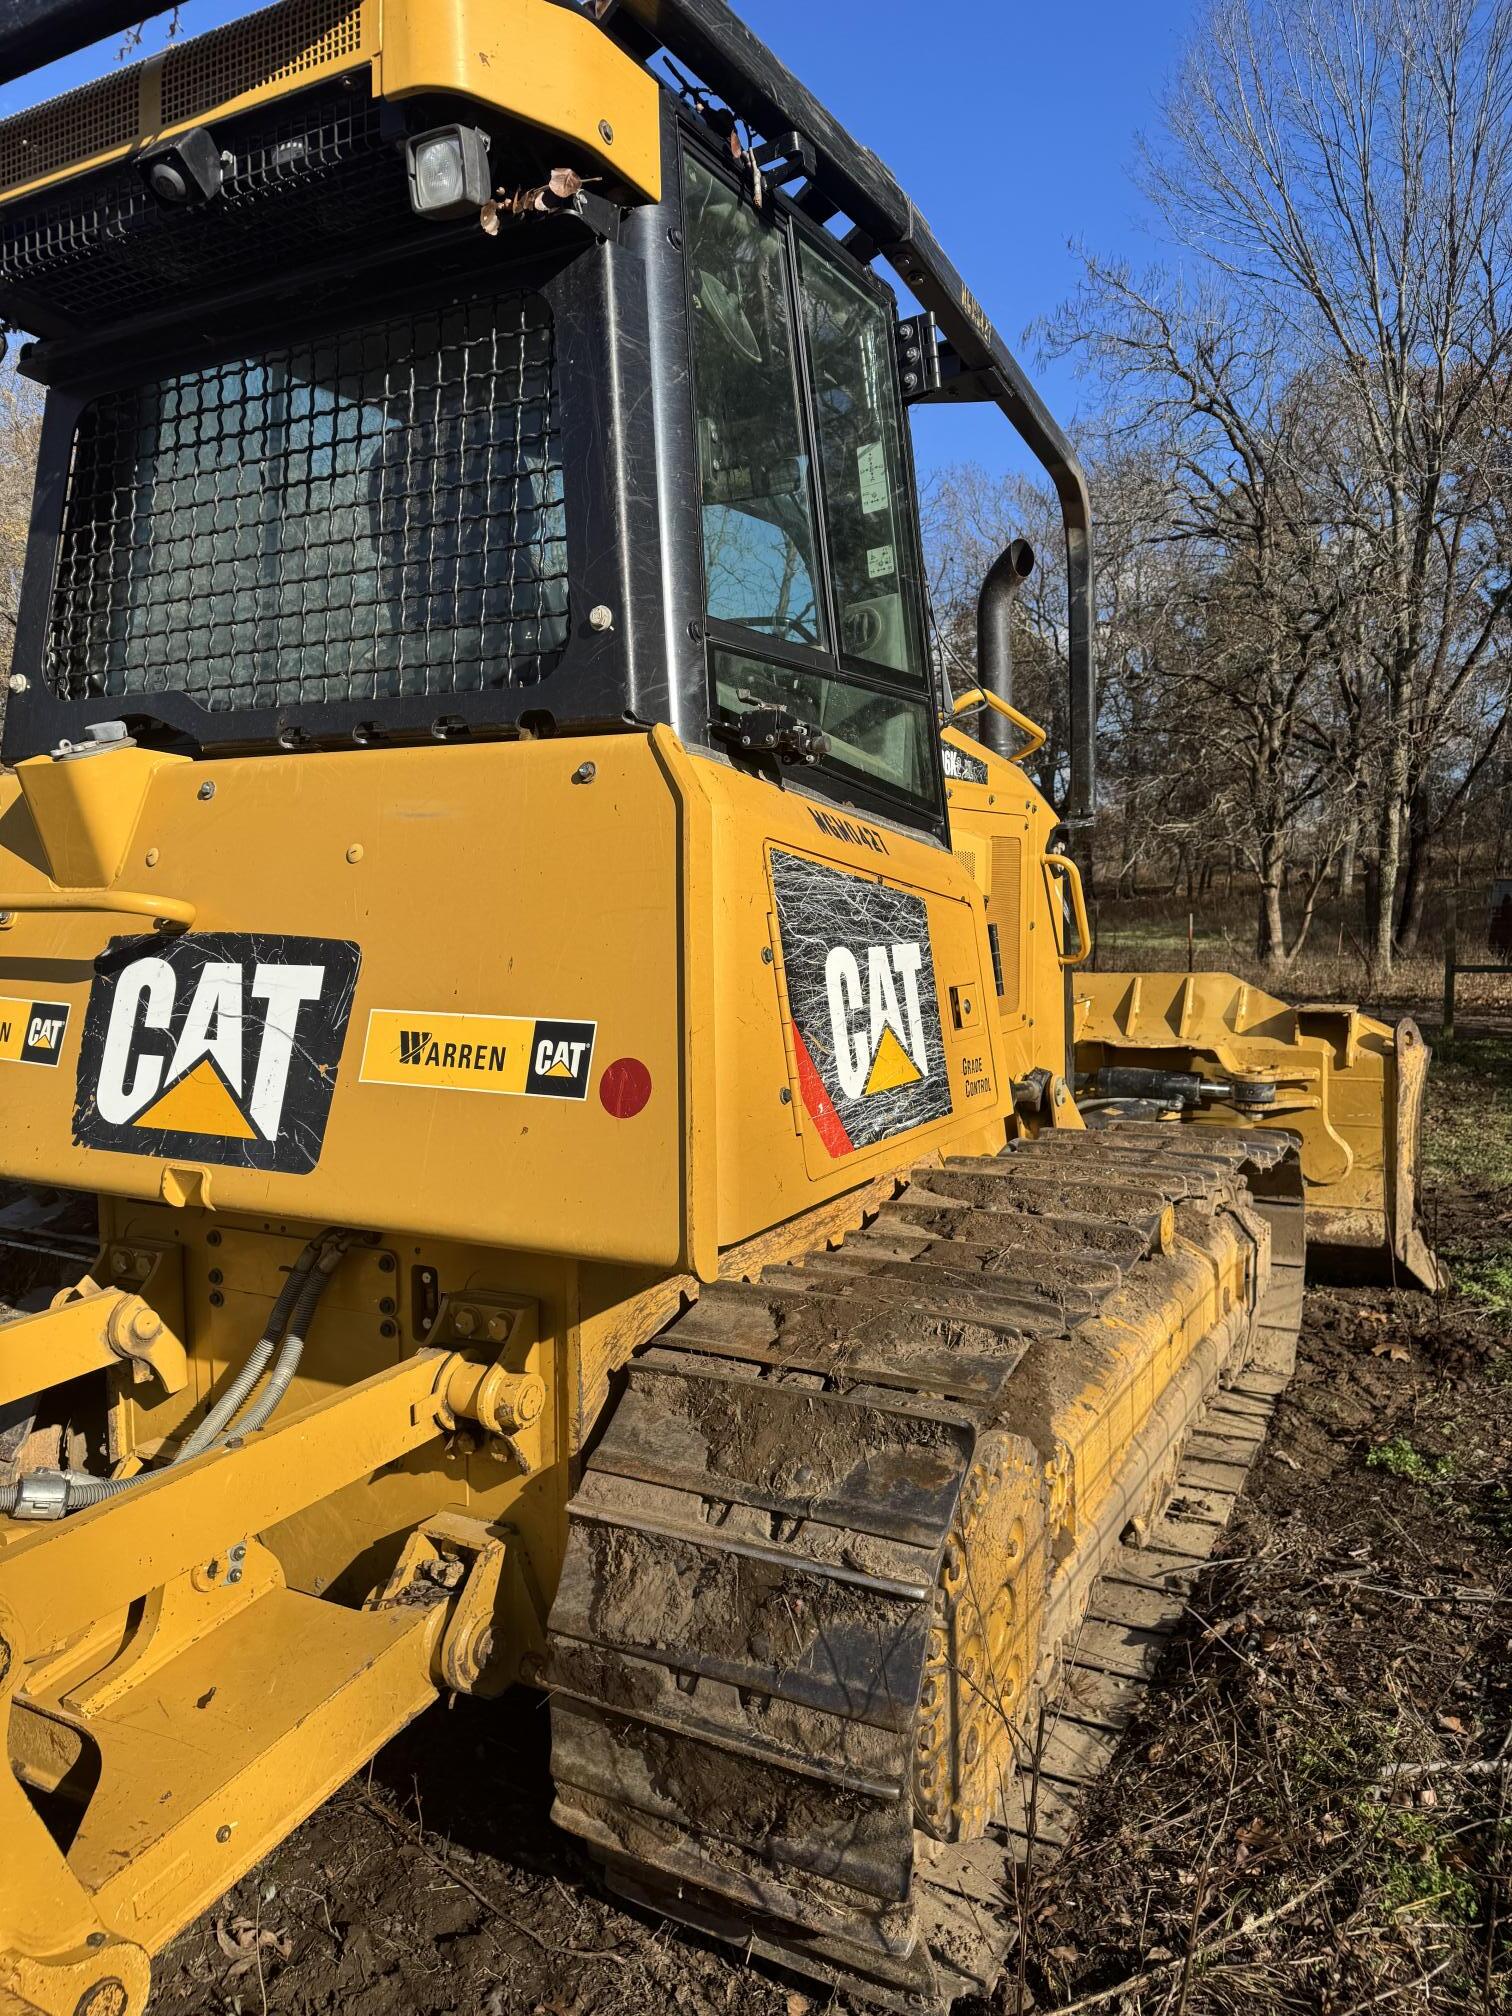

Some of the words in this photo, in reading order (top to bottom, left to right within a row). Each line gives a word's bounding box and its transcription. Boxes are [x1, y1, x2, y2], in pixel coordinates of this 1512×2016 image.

[27, 1017, 65, 1049] CAT
[825, 942, 928, 1099] CAT
[97, 957, 326, 1142] CAT
[399, 1030, 506, 1072] WARREN
[534, 1039, 588, 1078] CAT
[962, 1057, 982, 1076] GRADE
[965, 1077, 991, 1098] CONTROL
